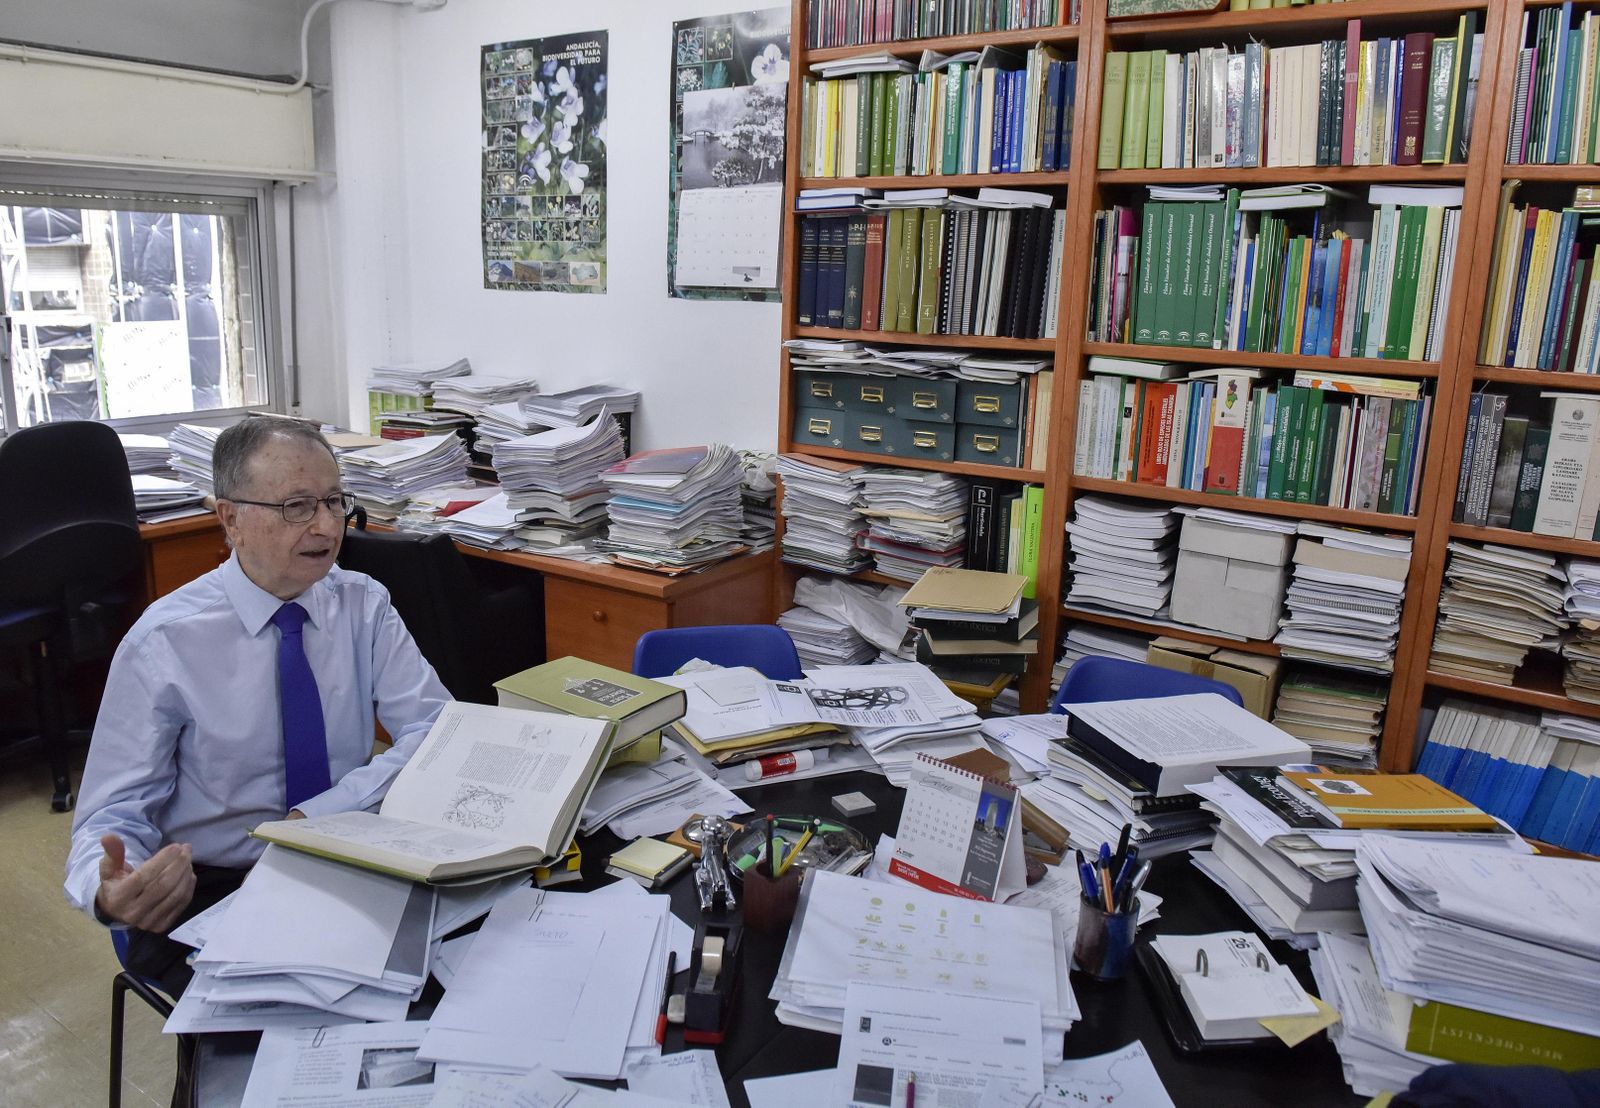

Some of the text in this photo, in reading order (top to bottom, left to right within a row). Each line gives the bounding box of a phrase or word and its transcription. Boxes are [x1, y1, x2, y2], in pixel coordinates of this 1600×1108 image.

[542, 51, 583, 61] BIODIVERSIDAD
[1245, 154, 1258, 163] 26
[923, 307, 931, 318] 4
[1232, 938, 1250, 949] 26
